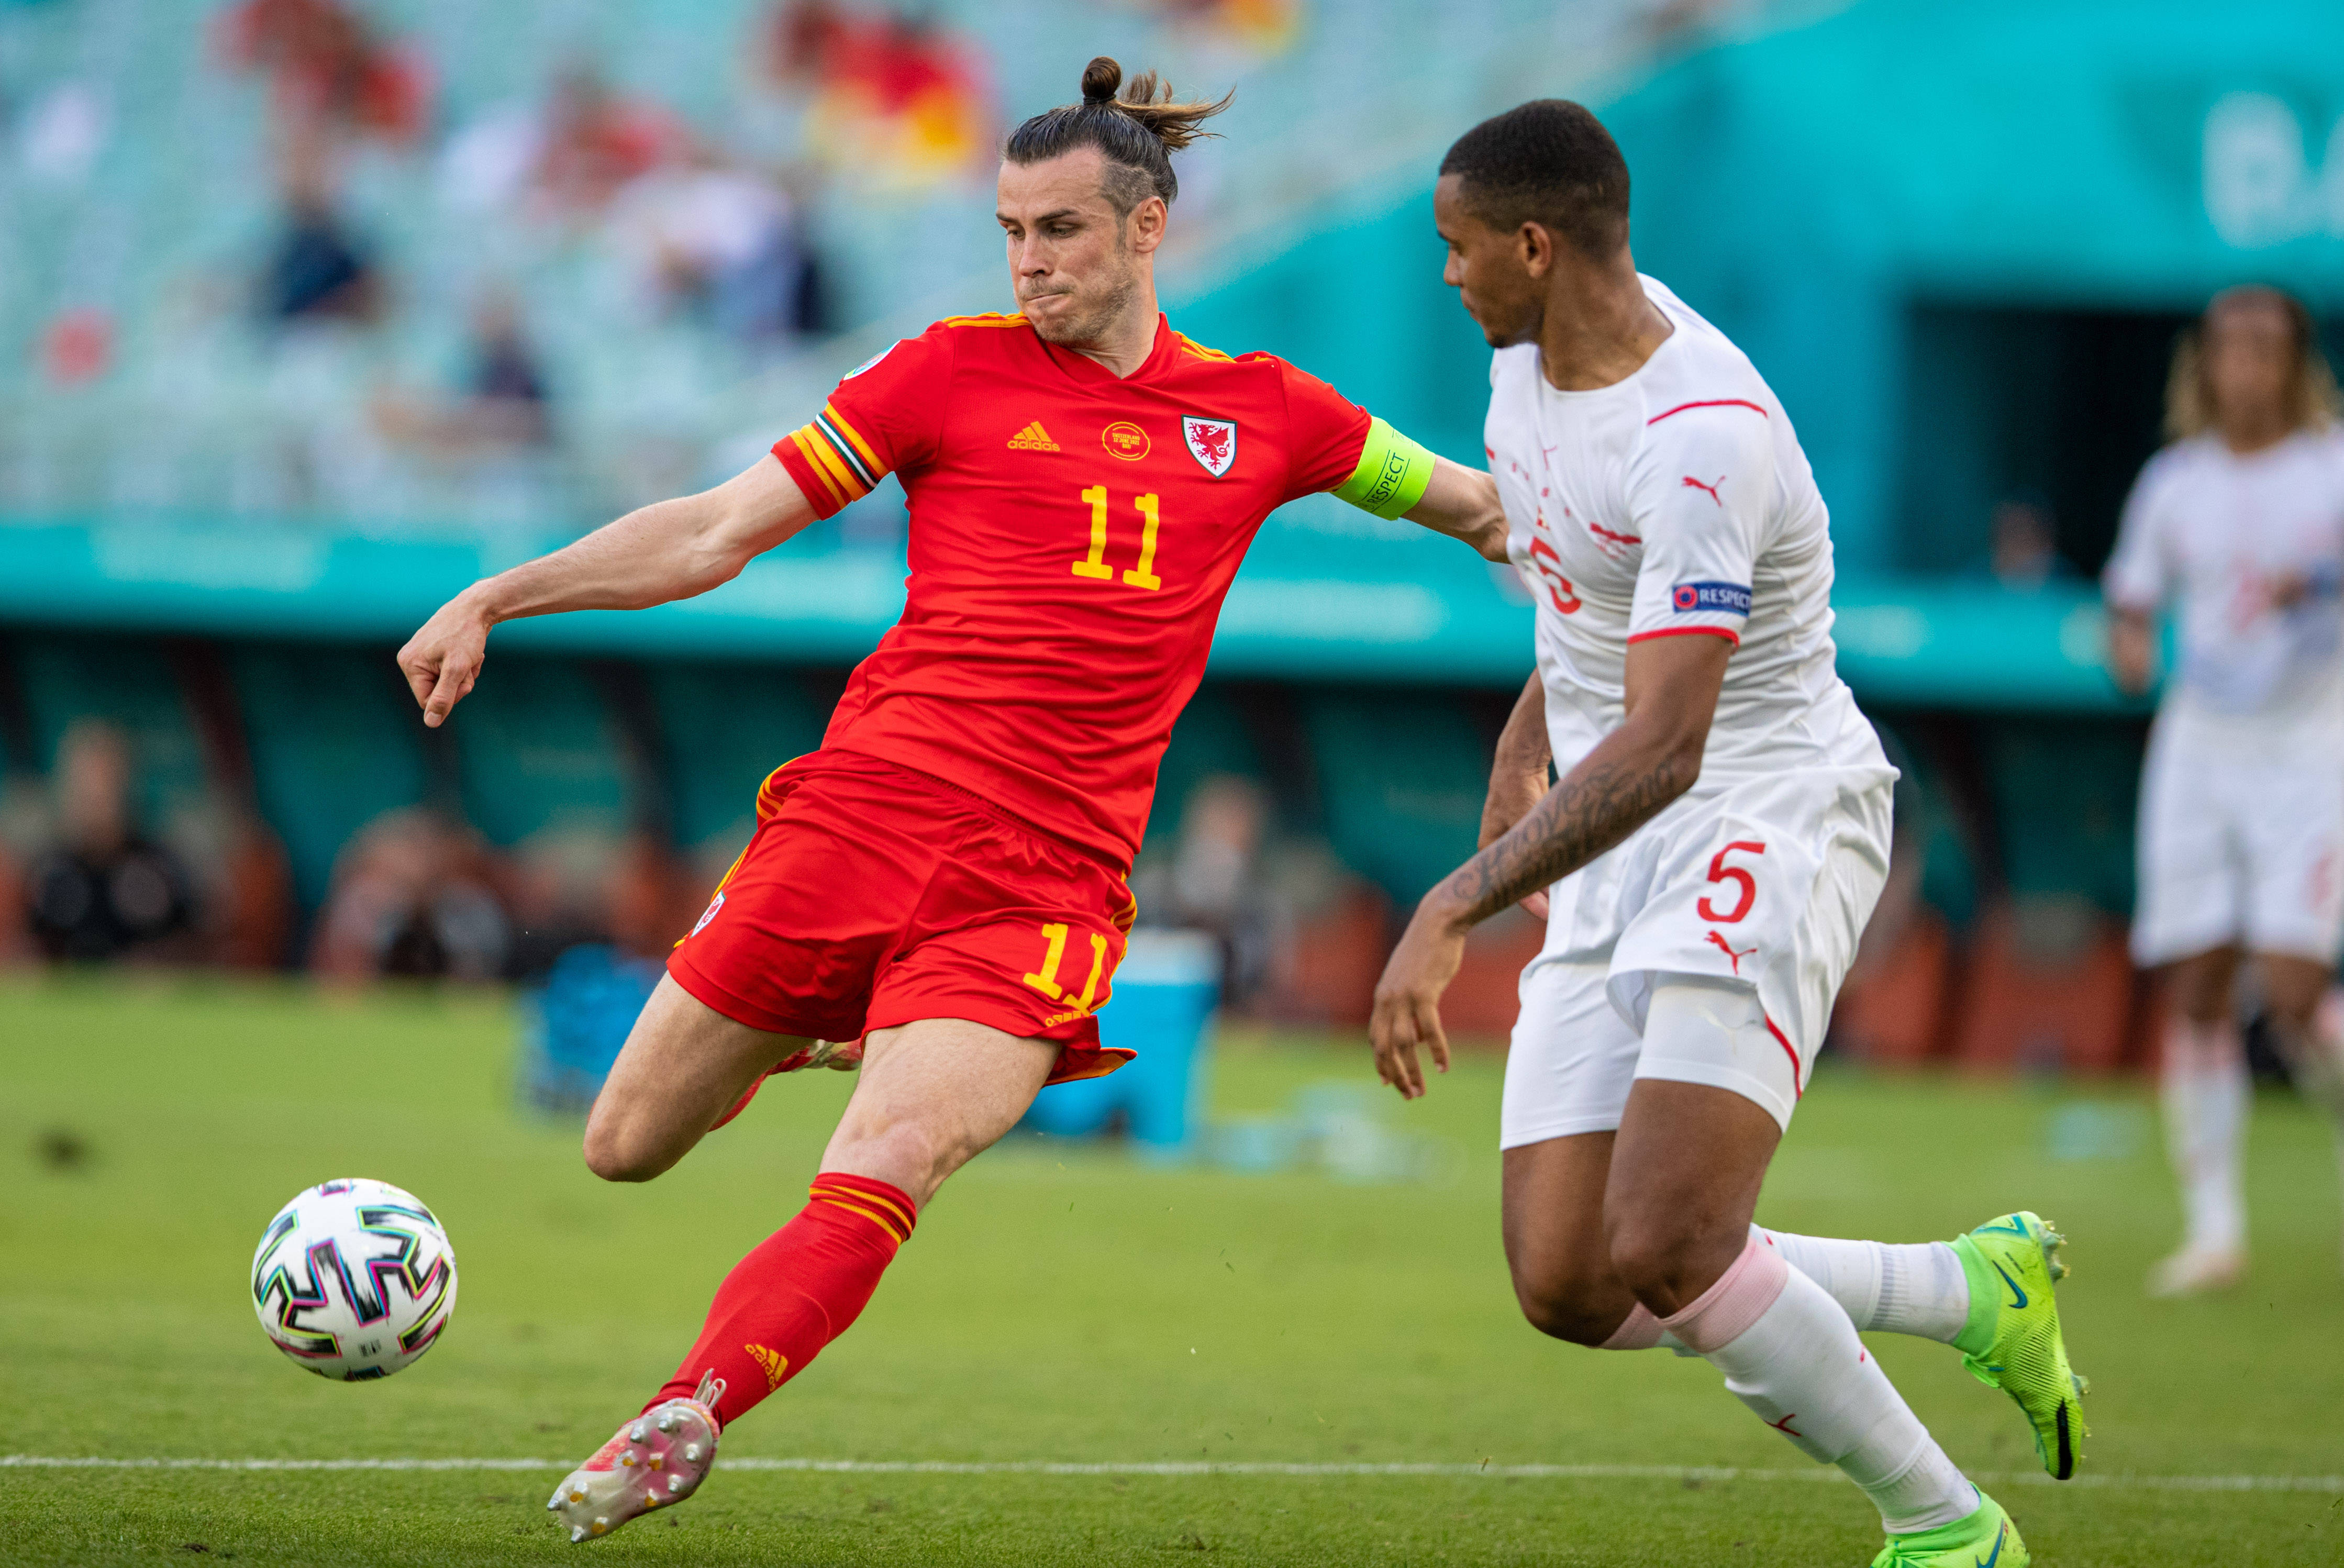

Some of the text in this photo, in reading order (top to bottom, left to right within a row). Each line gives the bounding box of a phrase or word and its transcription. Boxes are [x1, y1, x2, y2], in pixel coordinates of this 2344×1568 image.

[1007, 439, 1060, 451] adidas
[1367, 452, 1404, 504] RESPECT
[1072, 485, 1161, 591] 11
[1529, 535, 1582, 615] 5
[1697, 841, 1765, 923] 5
[1023, 922, 1107, 1017] 11
[745, 1344, 776, 1392] adidas
